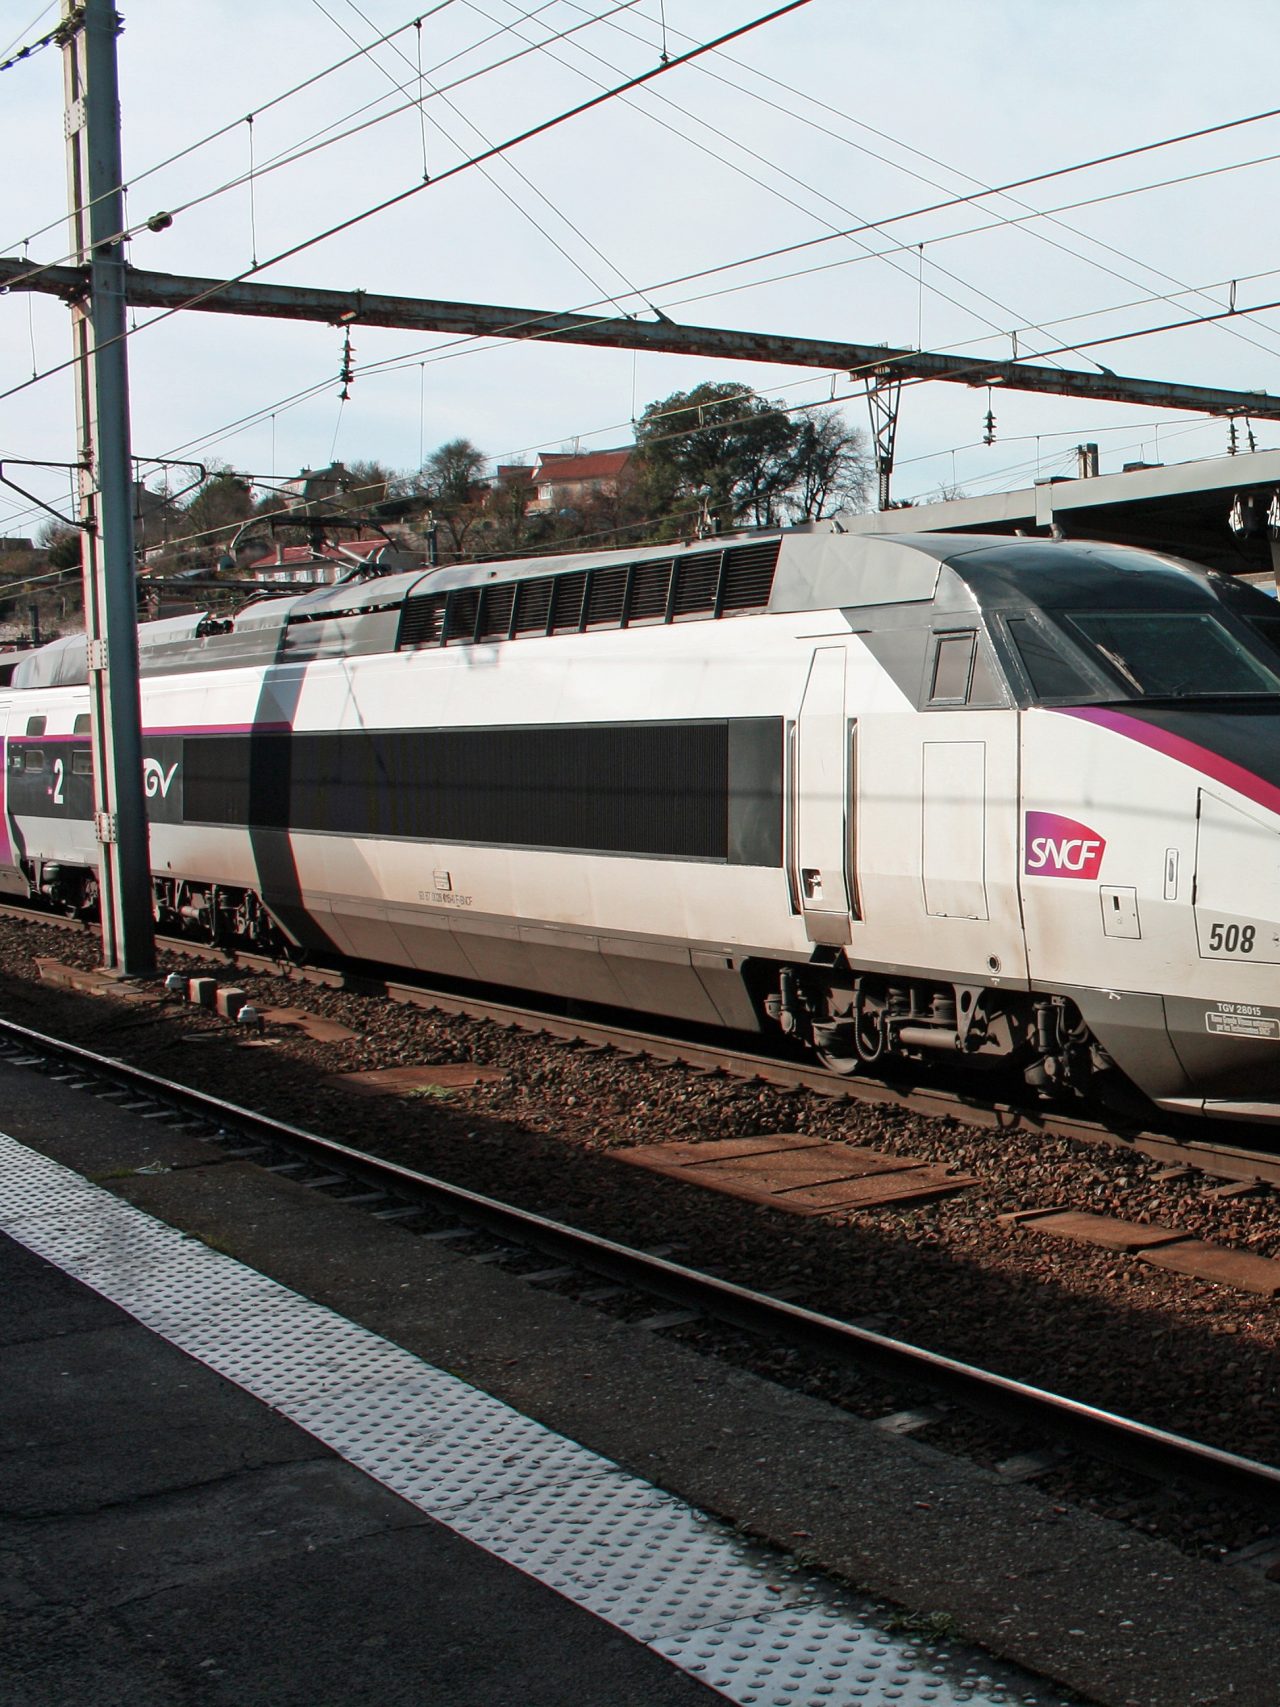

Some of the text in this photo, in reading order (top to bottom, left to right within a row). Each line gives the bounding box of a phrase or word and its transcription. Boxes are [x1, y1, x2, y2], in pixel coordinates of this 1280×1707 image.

[53, 758, 64, 805] 2
[143, 757, 179, 798] GV
[1028, 837, 1100, 871] SNCF
[1208, 923, 1256, 954] 508
[1216, 1002, 1262, 1016] TGV 28015
